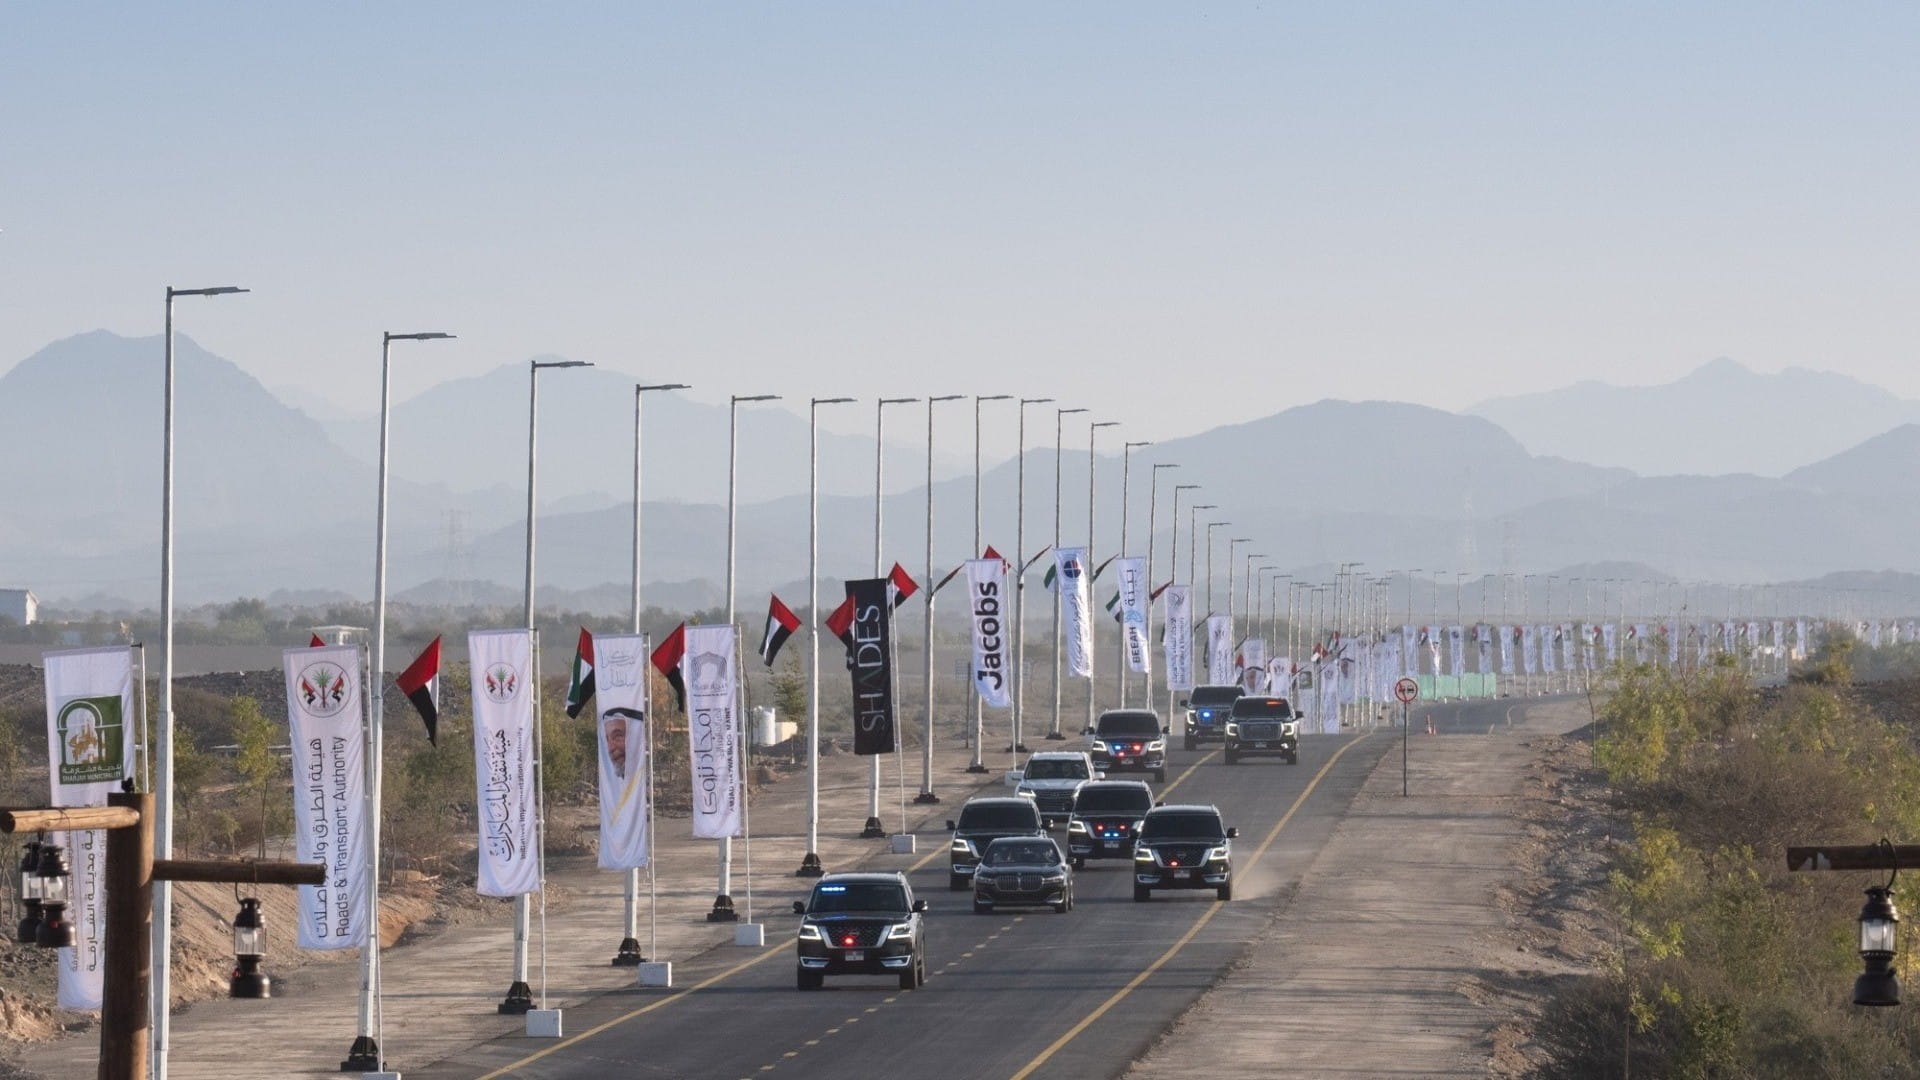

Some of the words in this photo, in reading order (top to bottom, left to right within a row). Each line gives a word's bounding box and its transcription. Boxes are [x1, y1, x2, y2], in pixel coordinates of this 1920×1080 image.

[974, 580, 1003, 690] Jacobs
[1129, 627, 1141, 664] BEEAH
[856, 604, 886, 732] SHADES
[308, 738, 324, 782] هيئة
[332, 736, 347, 801] Authority
[309, 785, 329, 839] الطرق
[334, 805, 349, 874] Transport
[85, 853, 97, 901] مدينة
[334, 878, 346, 888] &
[86, 904, 98, 972] الشارقة
[335, 893, 350, 937] Roads
